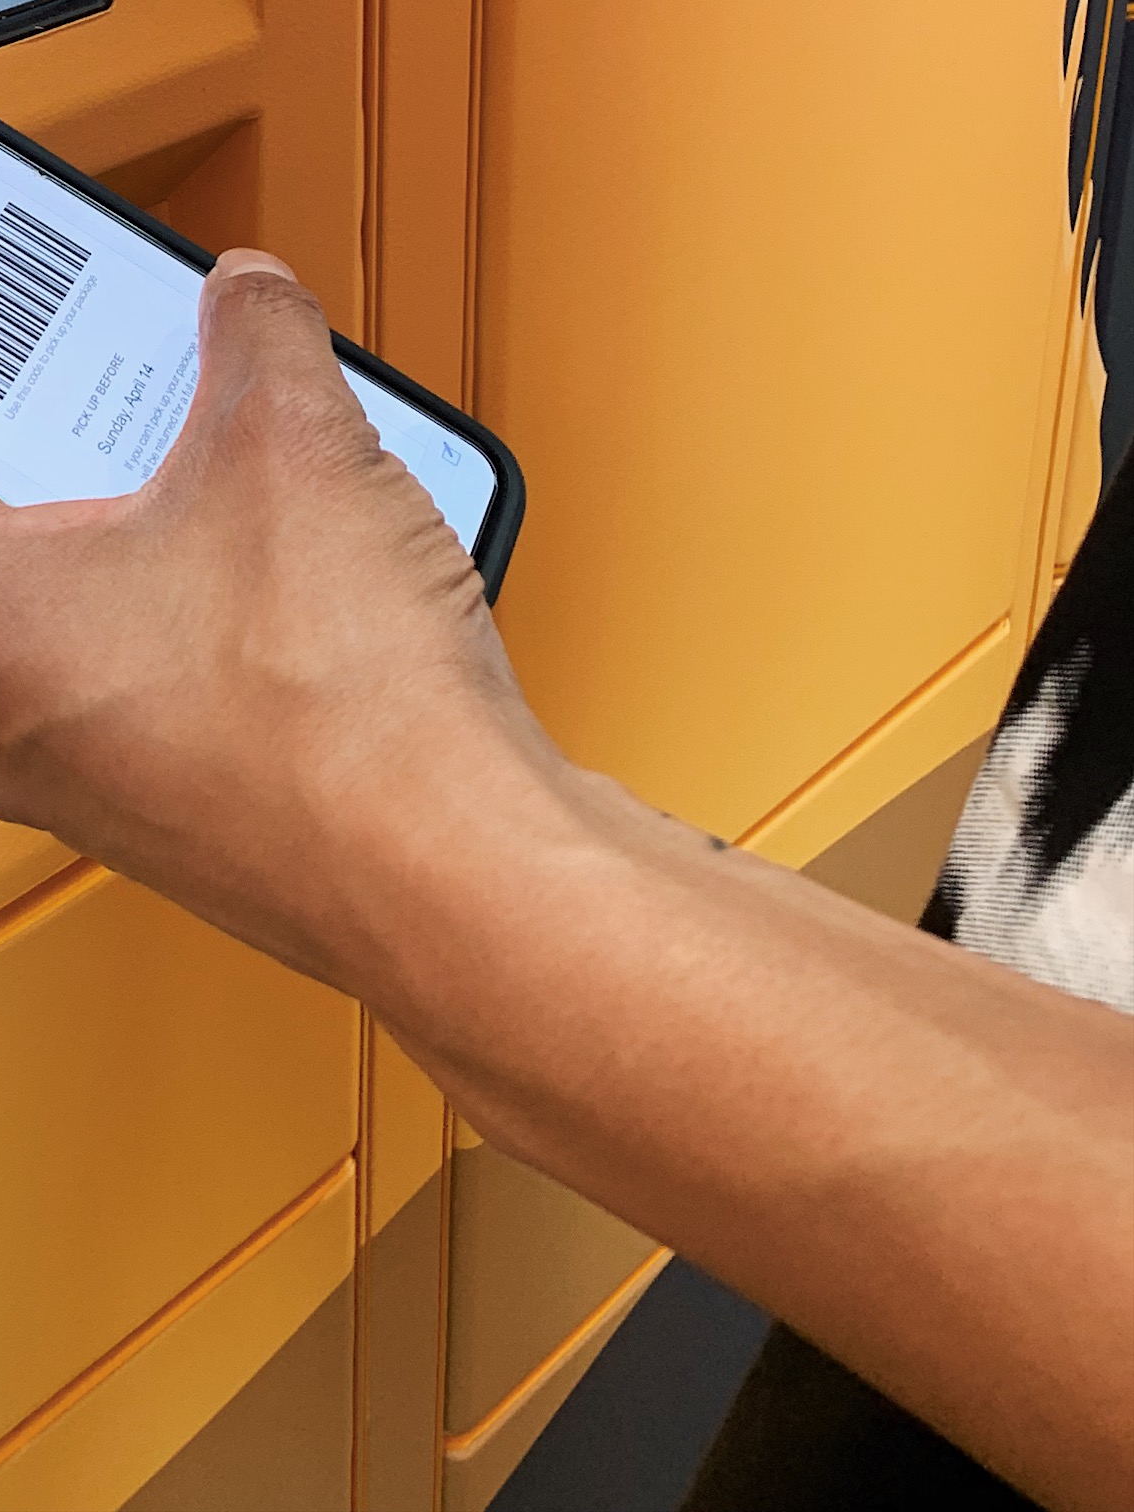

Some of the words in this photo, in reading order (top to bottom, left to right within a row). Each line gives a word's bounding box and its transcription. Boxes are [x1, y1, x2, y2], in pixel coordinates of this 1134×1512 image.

[4, 400, 22, 420] Use
[16, 385, 31, 401] this
[27, 363, 44, 385] code
[39, 353, 50, 364] to
[46, 336, 60, 356] pick
[56, 326, 68, 339] up
[63, 307, 77, 328] your
[74, 274, 98, 310] package
[72, 410, 93, 438] PICK
[86, 394, 100, 412] UP
[95, 352, 125, 396] BEFORE
[97, 408, 134, 455] Sunday,
[124, 375, 147, 408] April
[139, 363, 155, 379] 14
[172, 402, 184, 416] for
[182, 382, 195, 399] full
[124, 458, 134, 471] If
[130, 445, 144, 466] you
[139, 422, 155, 446] can't
[150, 406, 165, 428] pick
[159, 394, 171, 409] up
[166, 375, 180, 398] your
[155, 415, 179, 452] returned
[141, 463, 155, 480] will
[146, 450, 160, 465] be
